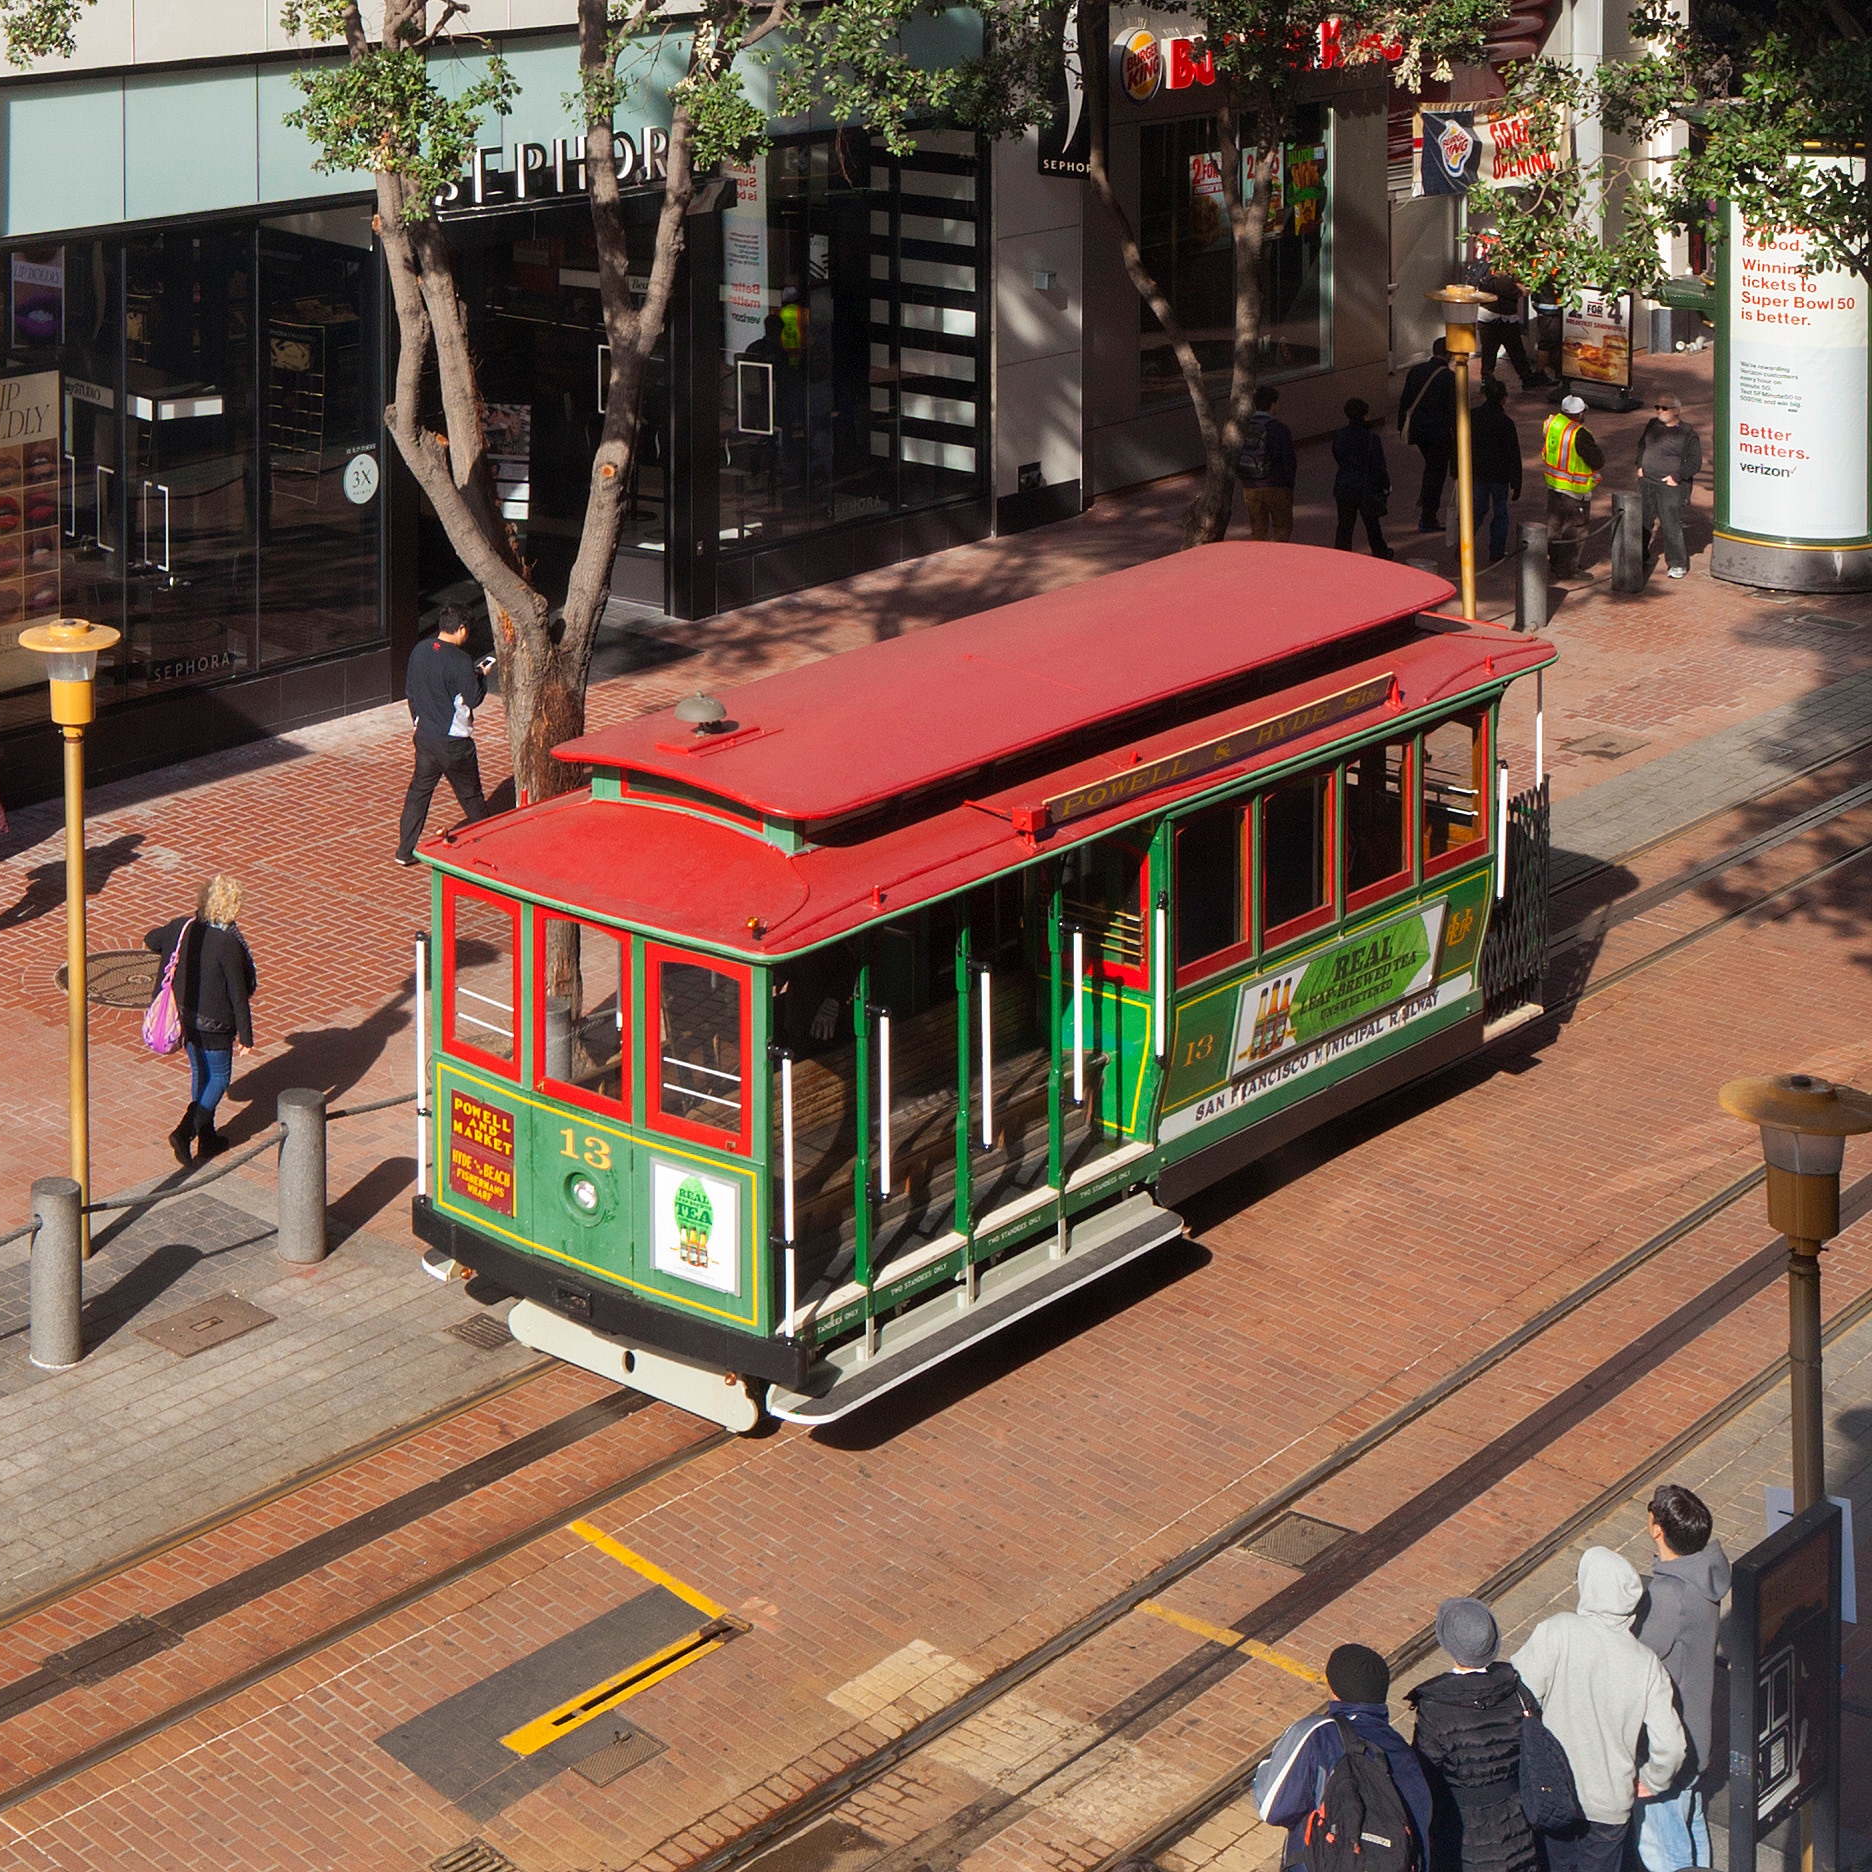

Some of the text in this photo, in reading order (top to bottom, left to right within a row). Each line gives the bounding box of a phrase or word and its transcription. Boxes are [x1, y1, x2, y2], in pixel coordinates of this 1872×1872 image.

[1128, 40, 1158, 69] BURGER
[1128, 56, 1160, 90] KING
[1043, 159, 1092, 174] SEPHOR
[1741, 275, 1797, 292] tickets
[1587, 303, 1603, 315] FOR
[1741, 291, 1855, 310] Super Bowl 50
[1741, 307, 1811, 326] is better.
[1739, 422, 1792, 442] Better
[1739, 442, 1810, 460] matters.
[1740, 462, 1790, 478] verizon
[154, 652, 230, 683] SEPHORA
[1062, 758, 1191, 817] POWELL
[1256, 708, 1329, 747] HYDE
[1332, 935, 1395, 984] REAL
[1393, 950, 1418, 976] TEA
[1183, 1034, 1215, 1068] 13
[454, 1097, 511, 1133] POWELL
[1195, 1094, 1226, 1122] SAN
[453, 1119, 512, 1156] MARKET
[469, 1118, 498, 1137] AND
[560, 1128, 613, 1171] 13
[452, 1149, 472, 1170] HYDE
[483, 1163, 511, 1188] BEACH
[456, 1167, 505, 1199] FISHERMANS
[467, 1184, 493, 1203] WHARF
[679, 1188, 709, 1205] REAL
[675, 1202, 713, 1226] TEA
[817, 1316, 843, 1334] TANDEES
